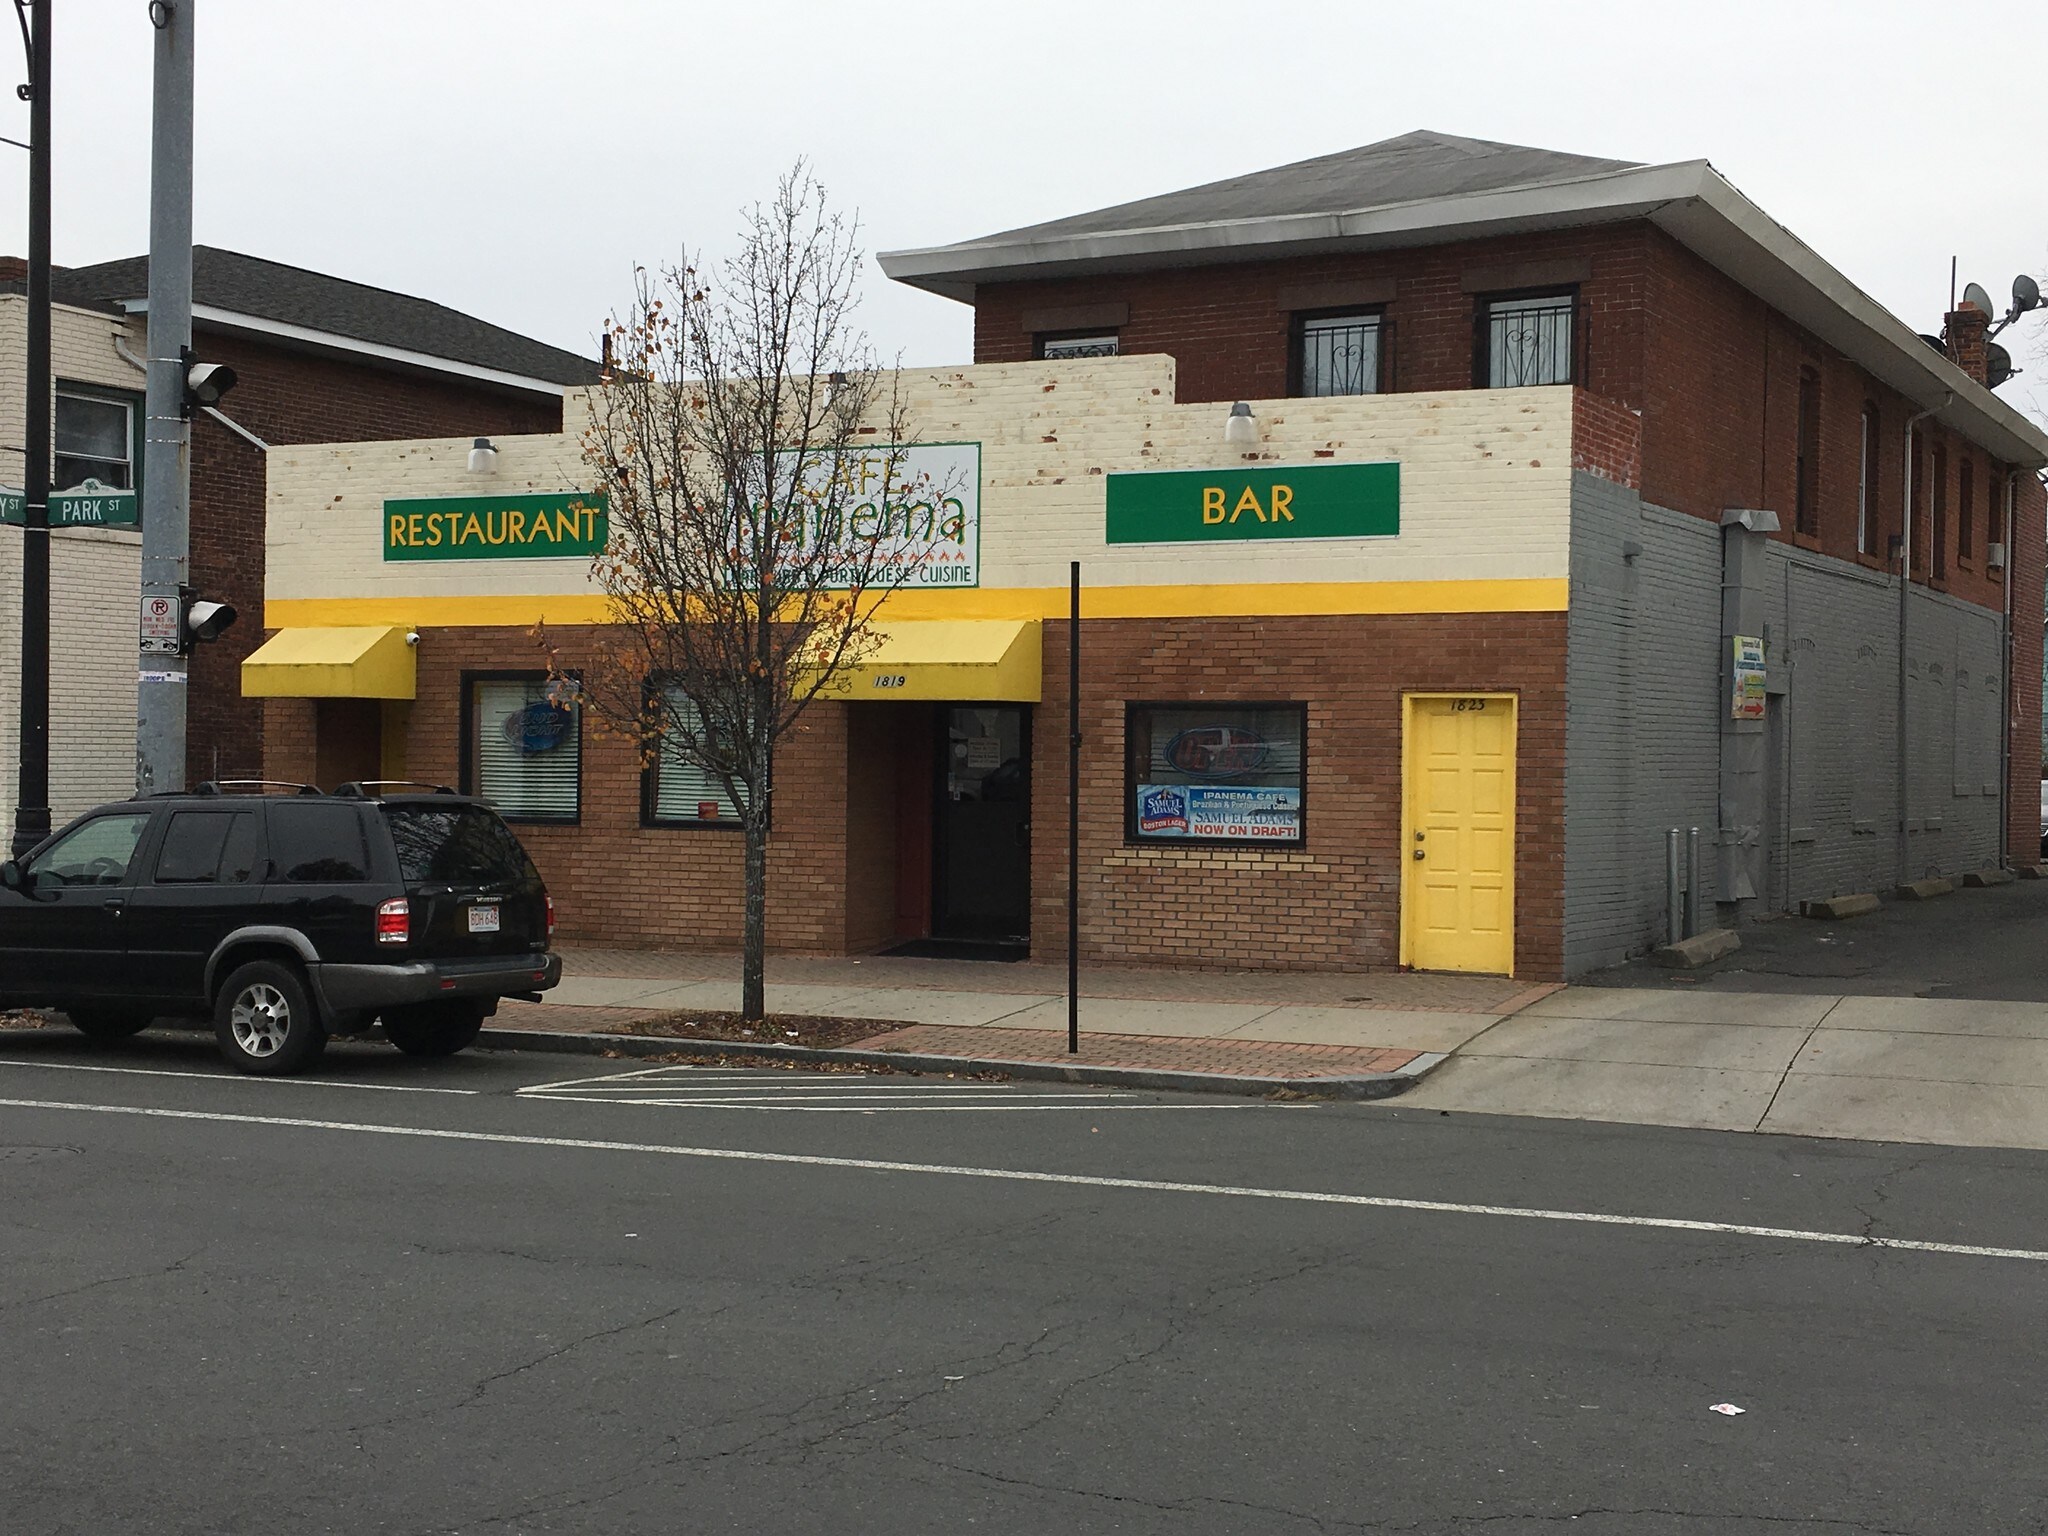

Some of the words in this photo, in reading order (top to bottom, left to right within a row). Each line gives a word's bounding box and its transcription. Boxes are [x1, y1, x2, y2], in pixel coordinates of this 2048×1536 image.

[9, 499, 19, 510] ST
[62, 500, 102, 521] PARK
[108, 500, 120, 511] ST
[1203, 484, 1295, 525] BAR
[390, 508, 600, 547] RESTAURANT
[920, 564, 971, 583] CUISINE
[875, 675, 906, 687] 1819
[1203, 791, 1253, 800] IPANEMA
[1256, 793, 1286, 801] CAFE
[1147, 798, 1183, 808] SAMUEL
[1150, 806, 1180, 816] ADAMS
[1143, 820, 1167, 830] BOSTON
[1167, 819, 1187, 828] LAGER
[1195, 812, 1246, 824] SAMUEL
[1249, 813, 1294, 825] ADAMS
[1194, 825, 1224, 834] NOW
[1228, 825, 1247, 835] ON
[1251, 826, 1297, 837] DRAFT!
